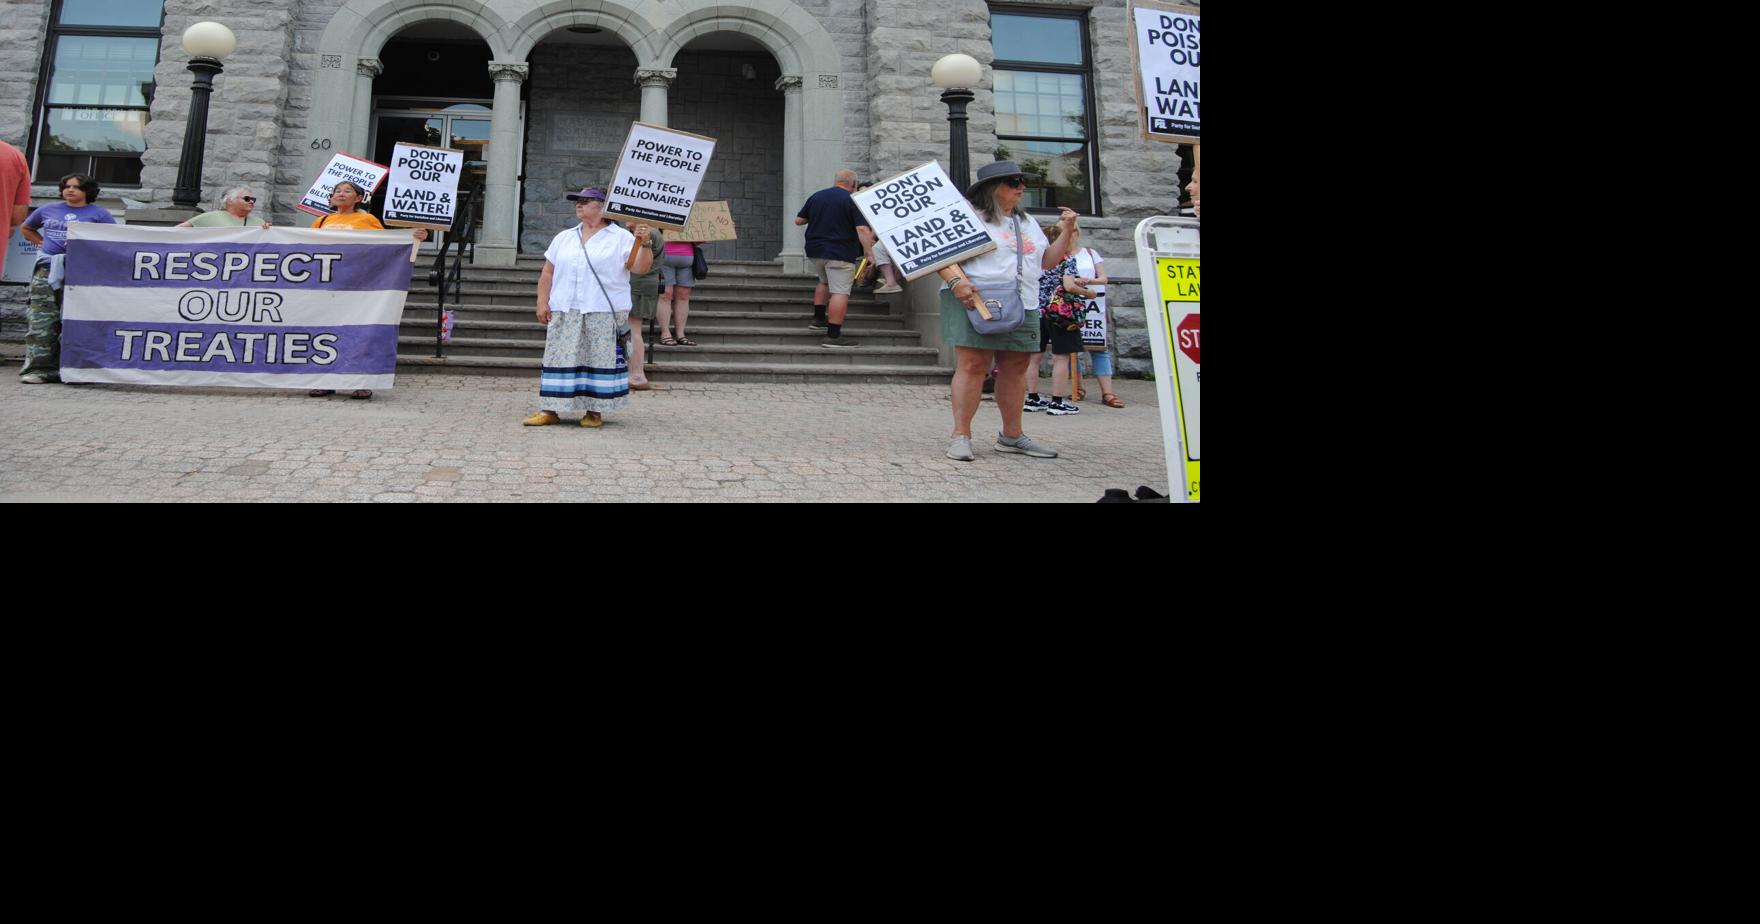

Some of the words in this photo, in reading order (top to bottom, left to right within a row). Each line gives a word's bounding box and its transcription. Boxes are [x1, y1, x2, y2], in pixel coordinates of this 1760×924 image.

[1148, 29, 1200, 50] POIS
[1155, 77, 1199, 99] LAN
[311, 138, 331, 150] 60
[636, 139, 682, 157] POWER
[687, 150, 703, 161] TO
[398, 157, 456, 174] POISON
[410, 149, 447, 162] DONT
[631, 150, 654, 163] THE
[655, 155, 701, 173] PEOPLE
[327, 168, 343, 179] THE
[342, 173, 374, 188] PEOPLE
[333, 161, 363, 177] POWER
[364, 171, 376, 181] TO
[410, 170, 441, 182] OUR
[321, 184, 334, 192] NO
[394, 187, 436, 202] LAND
[440, 193, 451, 203] &
[627, 176, 654, 189] NOT
[657, 182, 685, 195] TECH
[875, 172, 921, 200] DONT
[613, 186, 691, 208] BILLIONAIRES
[870, 177, 943, 215] POISON
[392, 199, 450, 215] WATER!
[894, 195, 936, 218] OUR
[716, 215, 729, 225] NO
[890, 218, 945, 247] LAND
[949, 209, 968, 223] &
[896, 220, 977, 259] WATER!
[132, 251, 342, 283] RESPECT
[178, 290, 283, 322] OUR
[1085, 319, 1103, 329] ER
[115, 329, 338, 365] TREATIES
[1181, 329, 1200, 348] ST
